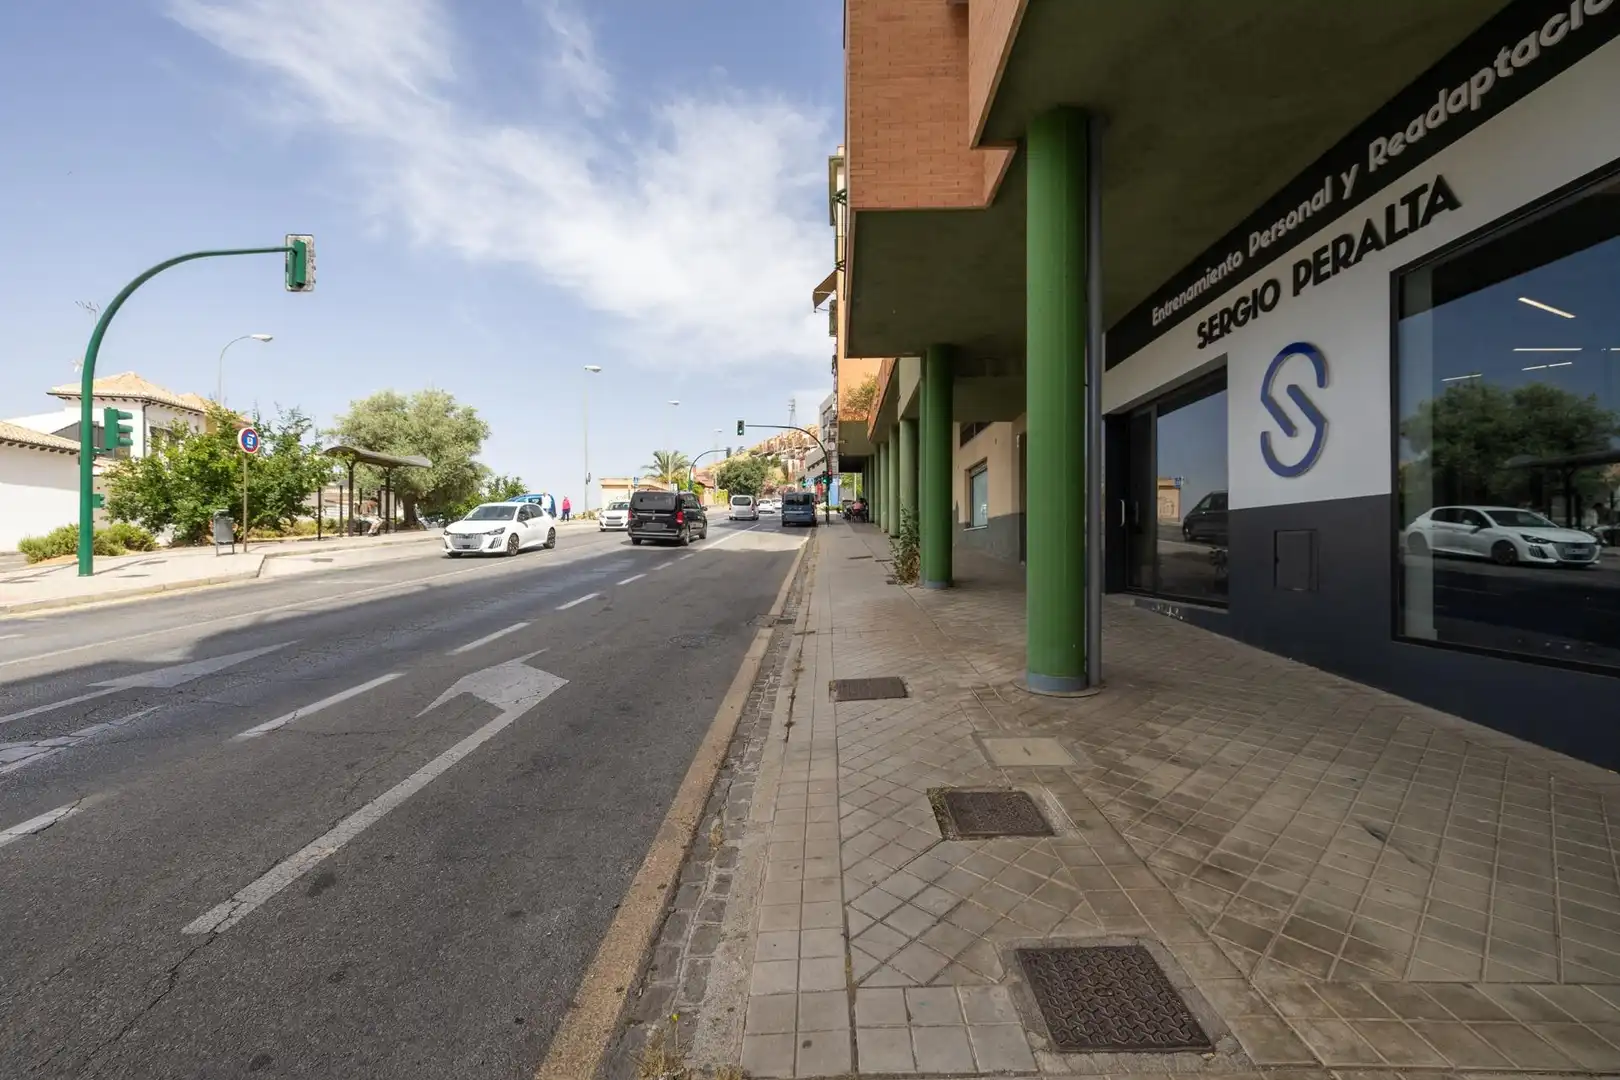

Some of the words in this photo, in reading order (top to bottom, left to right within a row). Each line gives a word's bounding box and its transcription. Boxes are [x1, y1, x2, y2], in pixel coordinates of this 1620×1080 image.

[1151, 249, 1244, 326] Entrenamiento
[1248, 175, 1333, 258] Personal
[1340, 163, 1359, 200] y
[1197, 278, 1281, 349] SERGIO
[1292, 174, 1462, 297] PERALTA
